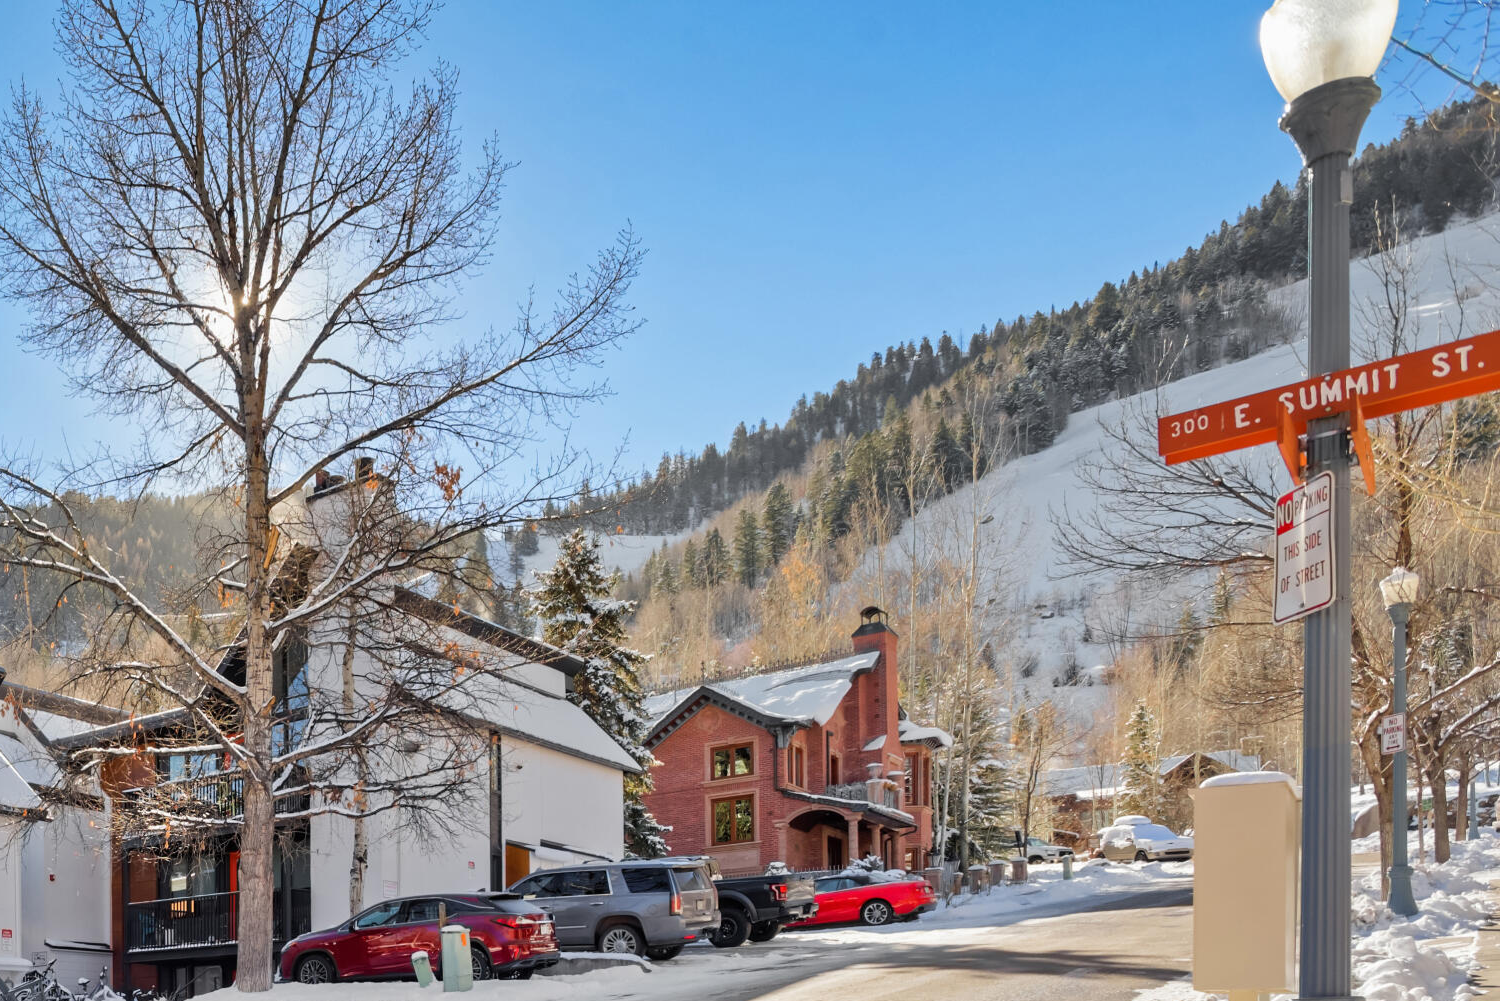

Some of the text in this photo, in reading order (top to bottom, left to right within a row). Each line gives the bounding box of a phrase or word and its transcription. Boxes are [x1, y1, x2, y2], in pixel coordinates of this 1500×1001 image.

[1170, 345, 1485, 438] 300 E. SUMMIT ST.
[1277, 500, 1292, 528] NO
[1284, 529, 1322, 562] THIS SIDE
[1280, 559, 1326, 594] OF STREET
[1383, 725, 1403, 735] PARKING
[1388, 718, 1398, 726] NO
